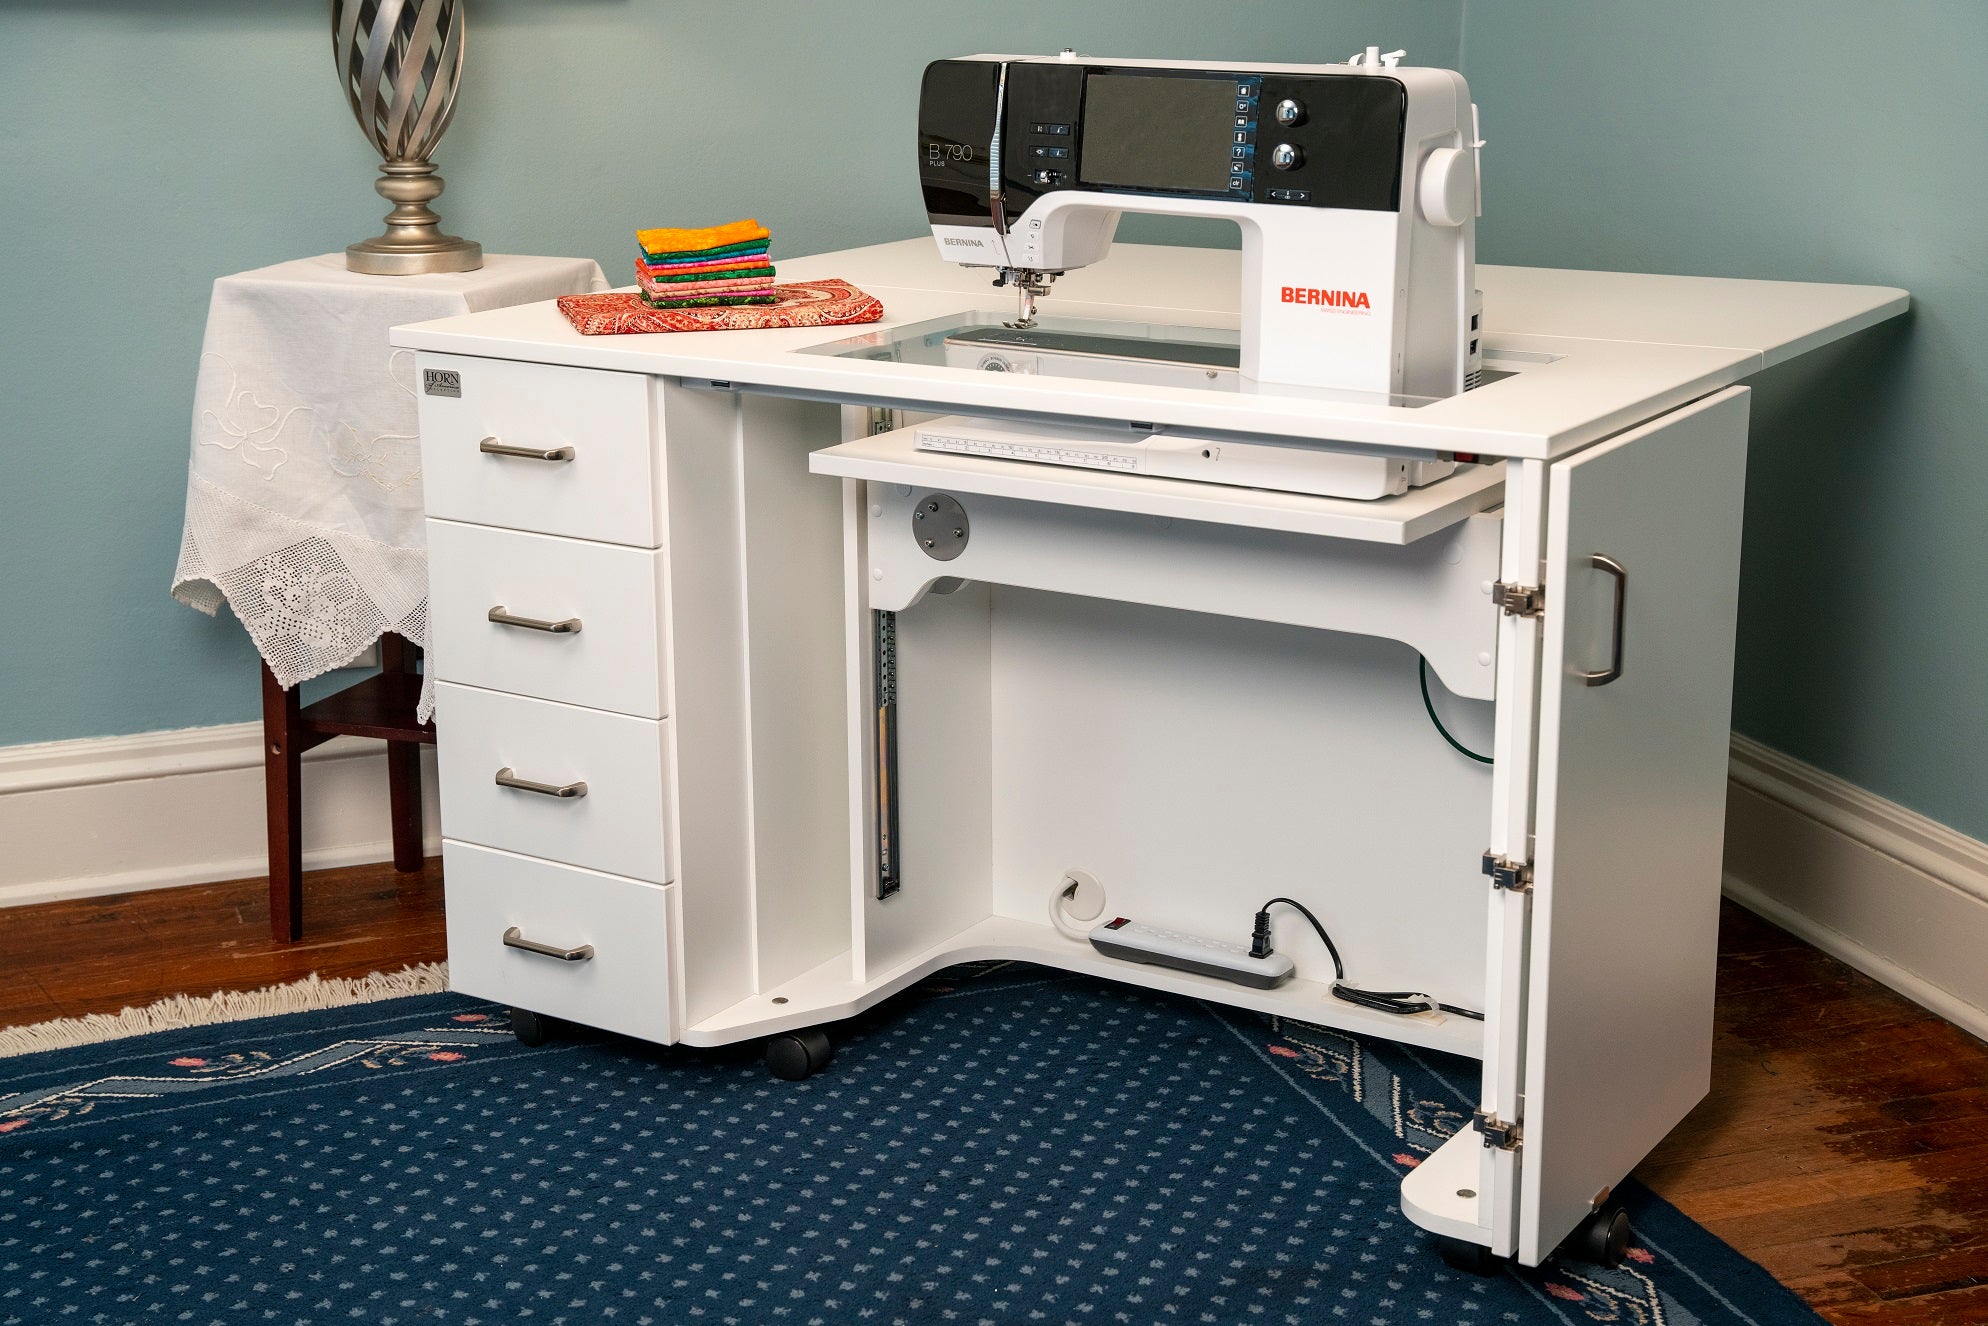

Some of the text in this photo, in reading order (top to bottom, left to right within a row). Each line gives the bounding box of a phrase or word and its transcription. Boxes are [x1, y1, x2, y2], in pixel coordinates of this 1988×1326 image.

[929, 143, 973, 161] B 790
[943, 237, 985, 248] BERNINA
[1281, 286, 1371, 309] BERNINA
[425, 371, 460, 385] HORN
